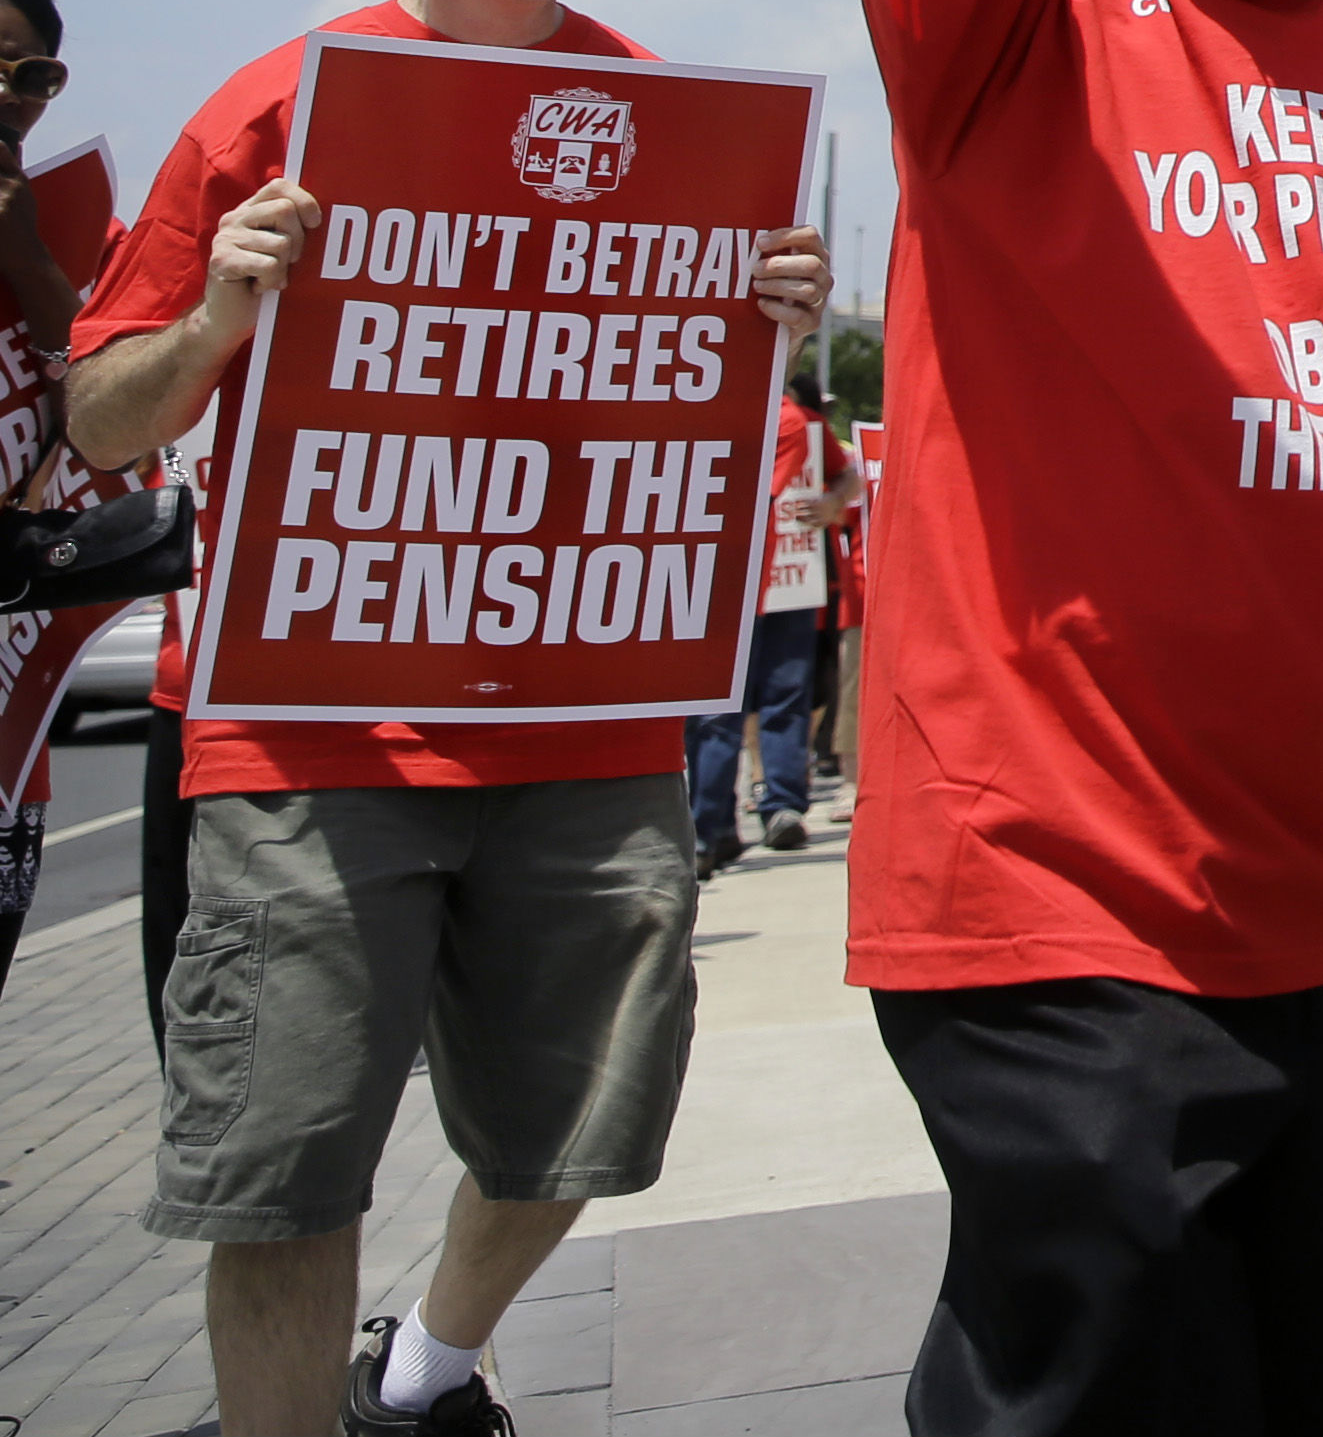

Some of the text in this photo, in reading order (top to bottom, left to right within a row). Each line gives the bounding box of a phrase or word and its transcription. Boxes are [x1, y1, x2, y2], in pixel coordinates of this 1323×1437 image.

[534, 102, 622, 138] CWA
[321, 204, 768, 300] DON'T BETRAY
[329, 300, 726, 402] RETIREES
[281, 429, 550, 534] FUND
[579, 439, 732, 534] THE
[261, 538, 719, 646] PENSION
